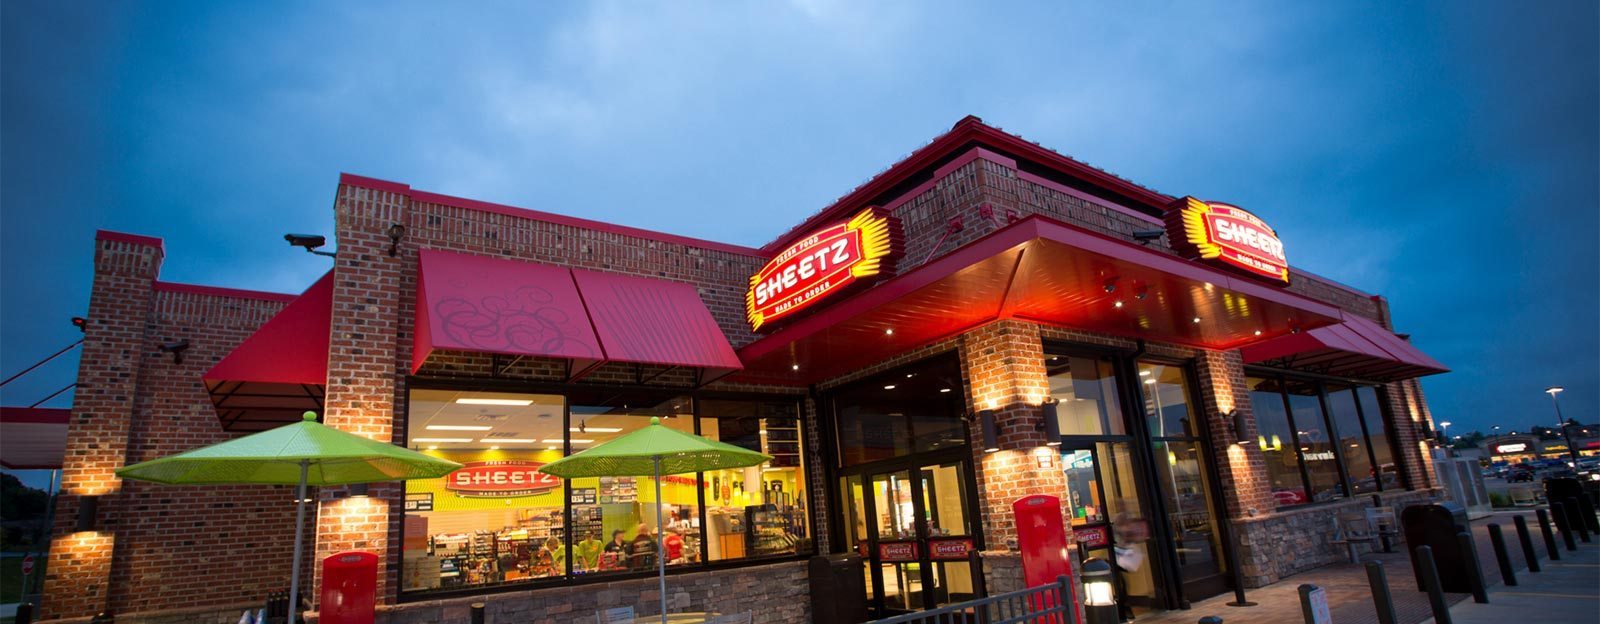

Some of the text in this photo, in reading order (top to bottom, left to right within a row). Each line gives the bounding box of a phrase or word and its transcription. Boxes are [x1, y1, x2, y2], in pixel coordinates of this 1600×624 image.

[776, 236, 819, 265] FRESH FOOD
[1215, 218, 1285, 260] SHEETZ
[755, 238, 849, 306] SHEETZ
[775, 281, 830, 313] MADE TO ORDER
[456, 471, 553, 485] SHEETZ
[937, 545, 965, 553] SHEETZ
